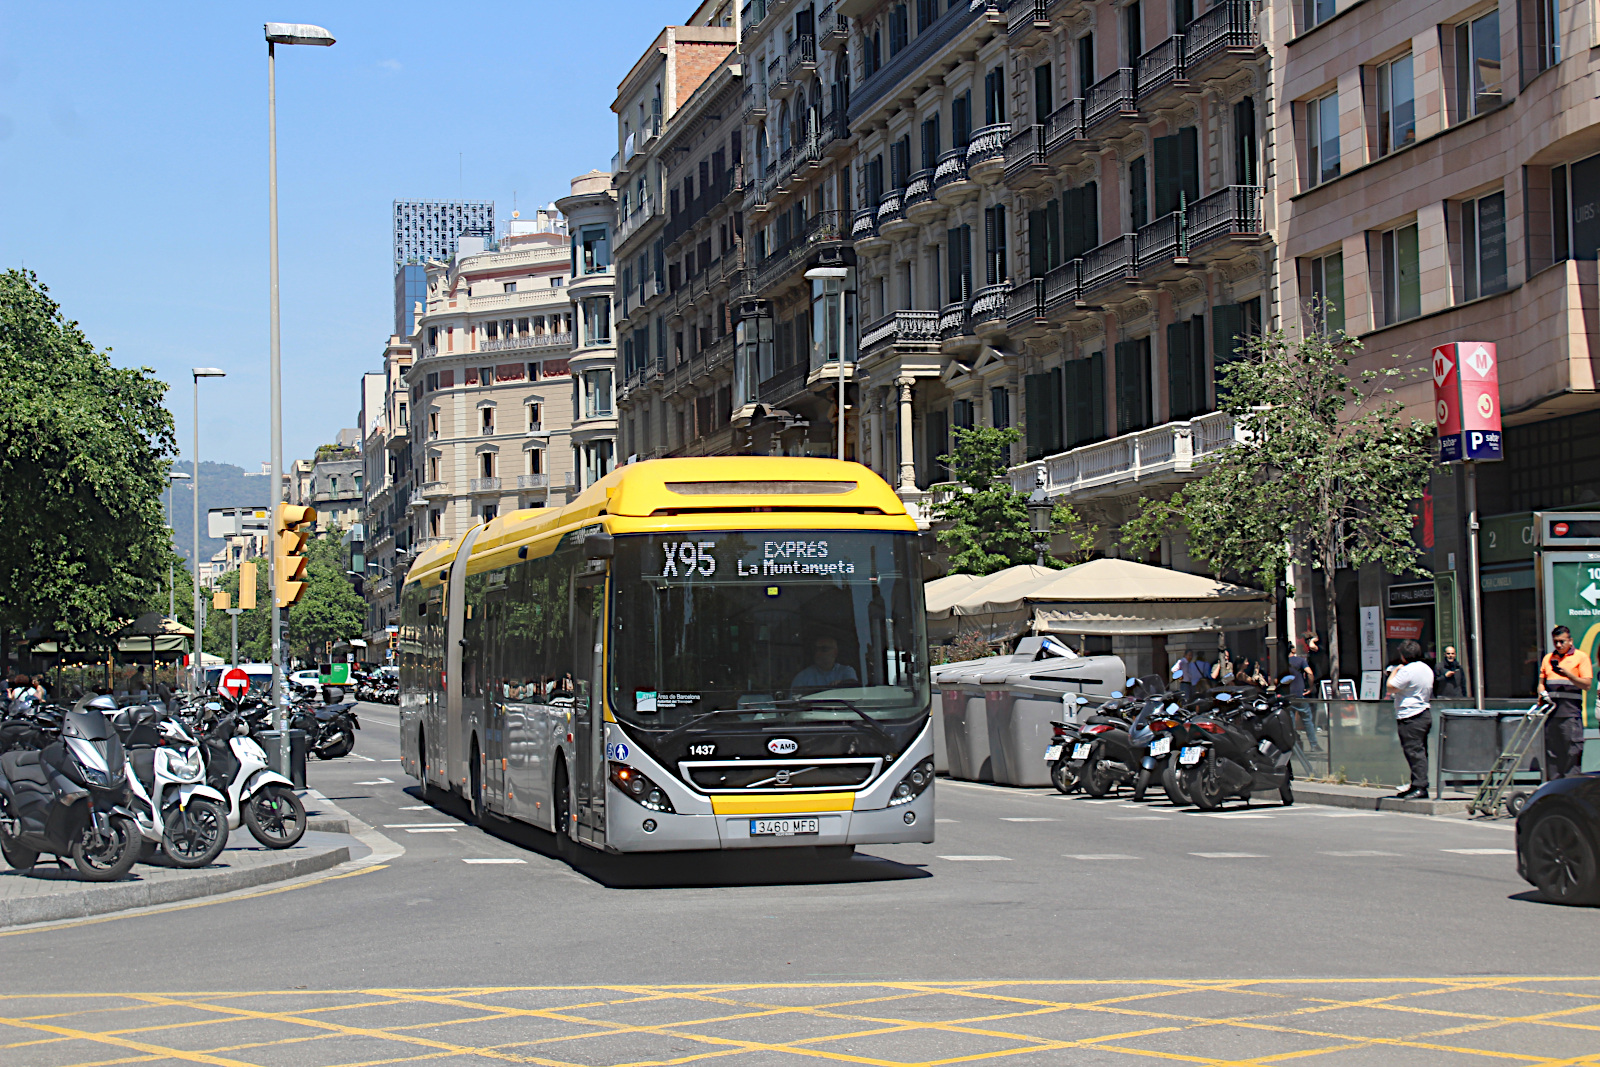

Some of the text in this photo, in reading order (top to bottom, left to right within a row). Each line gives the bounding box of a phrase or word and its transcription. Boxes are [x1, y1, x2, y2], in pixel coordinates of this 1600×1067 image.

[1435, 358, 1444, 377] M
[1475, 354, 1488, 369] M
[1471, 431, 1483, 450] P
[1489, 531, 1496, 548] 2
[764, 540, 828, 558] EXPRÉS
[662, 541, 716, 577] X95
[737, 559, 855, 576] La Muntanyeta
[689, 744, 715, 755] 1437
[758, 820, 816, 832] 3460 MFB
